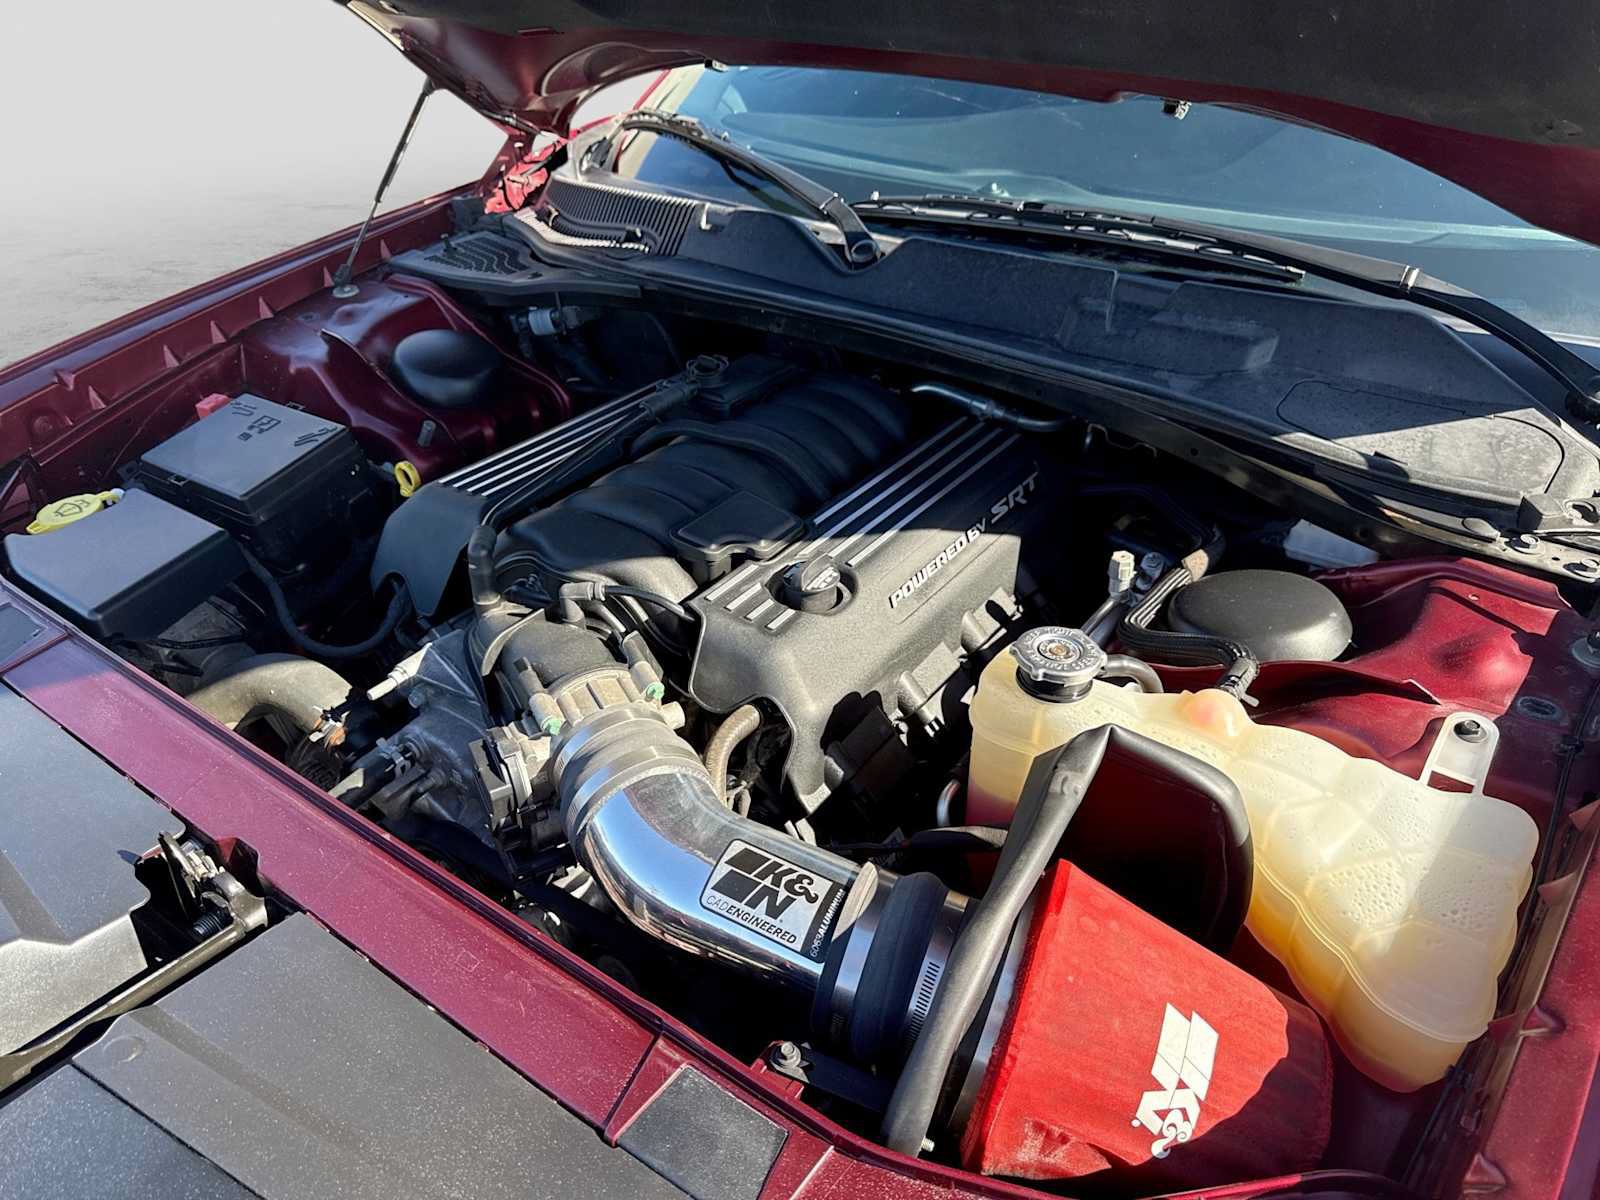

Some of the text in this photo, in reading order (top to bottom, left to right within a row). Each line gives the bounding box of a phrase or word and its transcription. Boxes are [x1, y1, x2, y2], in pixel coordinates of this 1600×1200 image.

[888, 471, 1039, 609] POWERED BY SRT
